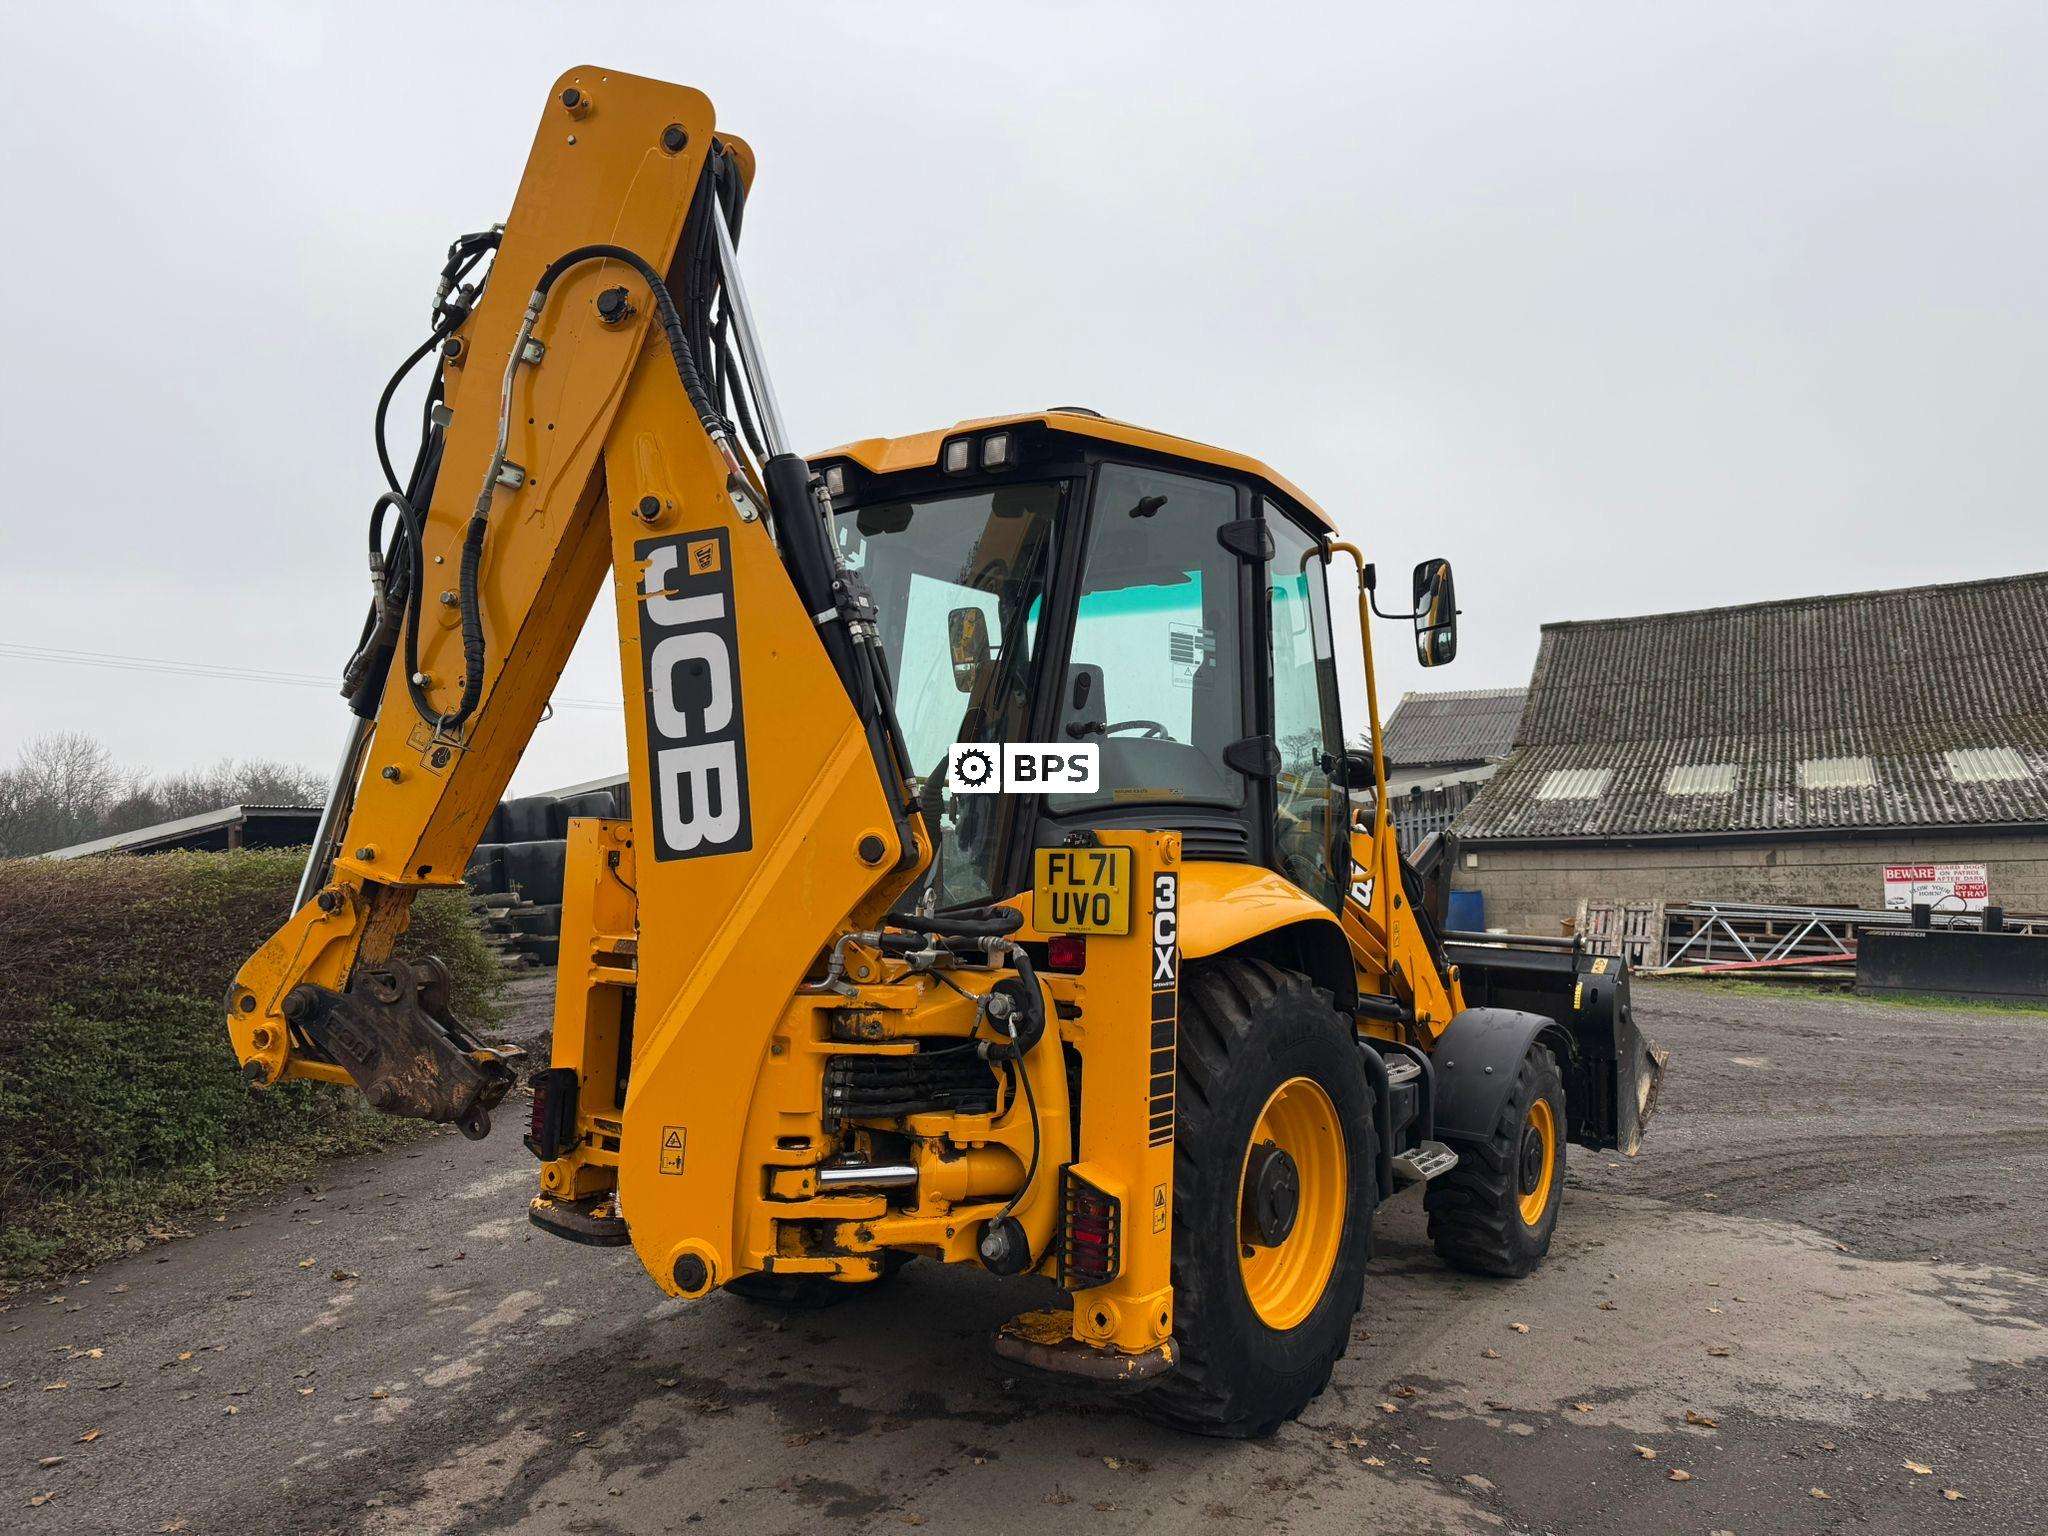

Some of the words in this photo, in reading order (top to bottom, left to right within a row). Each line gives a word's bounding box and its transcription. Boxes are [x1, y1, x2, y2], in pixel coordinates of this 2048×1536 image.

[696, 547, 711, 568] JCB
[645, 544, 740, 851] JCB
[1048, 853, 1116, 886] FL71
[1886, 868, 1935, 879] BEWARE
[1051, 892, 1111, 926] UVO
[1153, 876, 1176, 980] 3CX
[1885, 930, 1926, 938] STRIMECH
